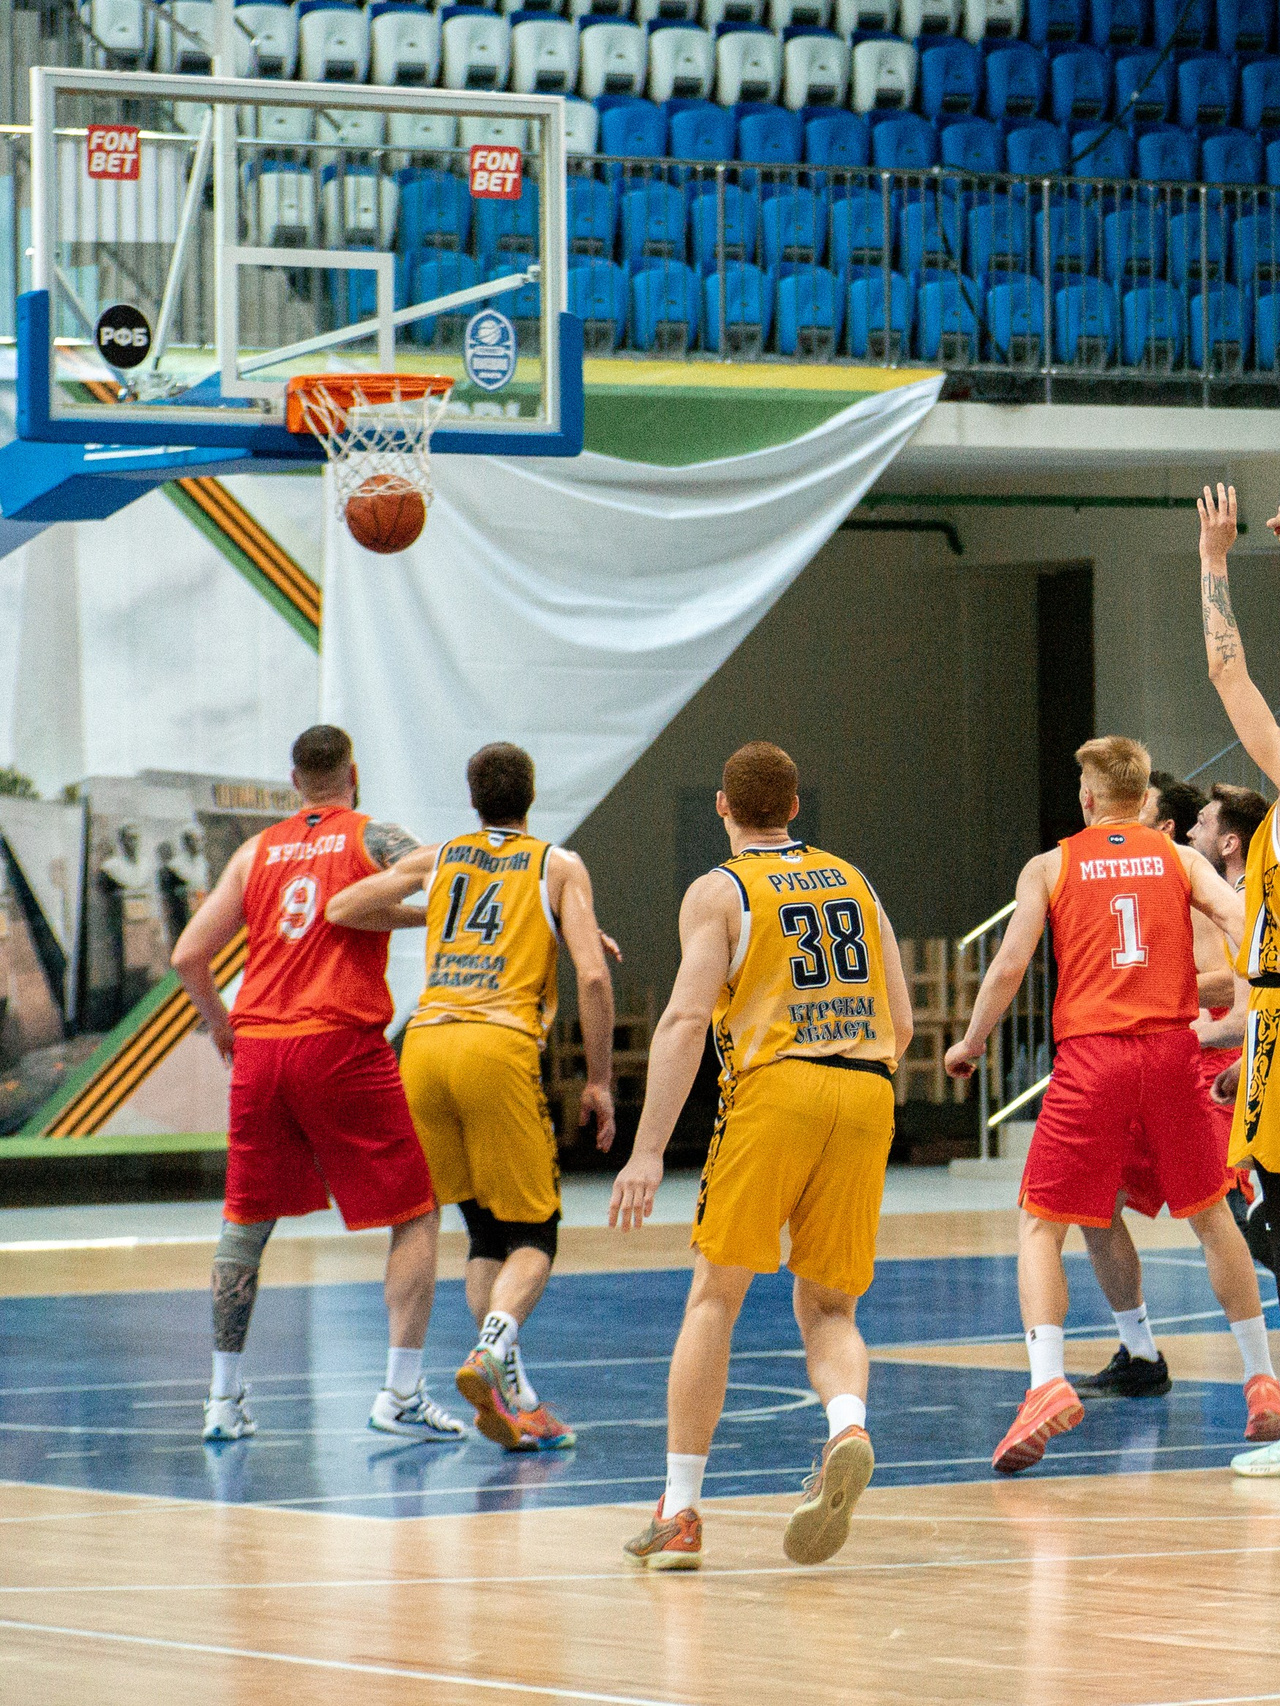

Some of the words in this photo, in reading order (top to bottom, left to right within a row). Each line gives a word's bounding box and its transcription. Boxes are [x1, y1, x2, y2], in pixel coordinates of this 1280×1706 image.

[90, 131, 137, 151] FON
[90, 151, 138, 173] BET
[472, 151, 519, 171] FON
[472, 171, 519, 192] BET
[100, 327, 148, 347] РФБ
[1080, 856, 1165, 880] МЕТЕЛЕВ
[767, 868, 848, 894] РУБЛЕВ
[278, 872, 320, 944] 9
[441, 872, 504, 945] 14
[1110, 893, 1149, 969] 1
[778, 898, 869, 990] 38
